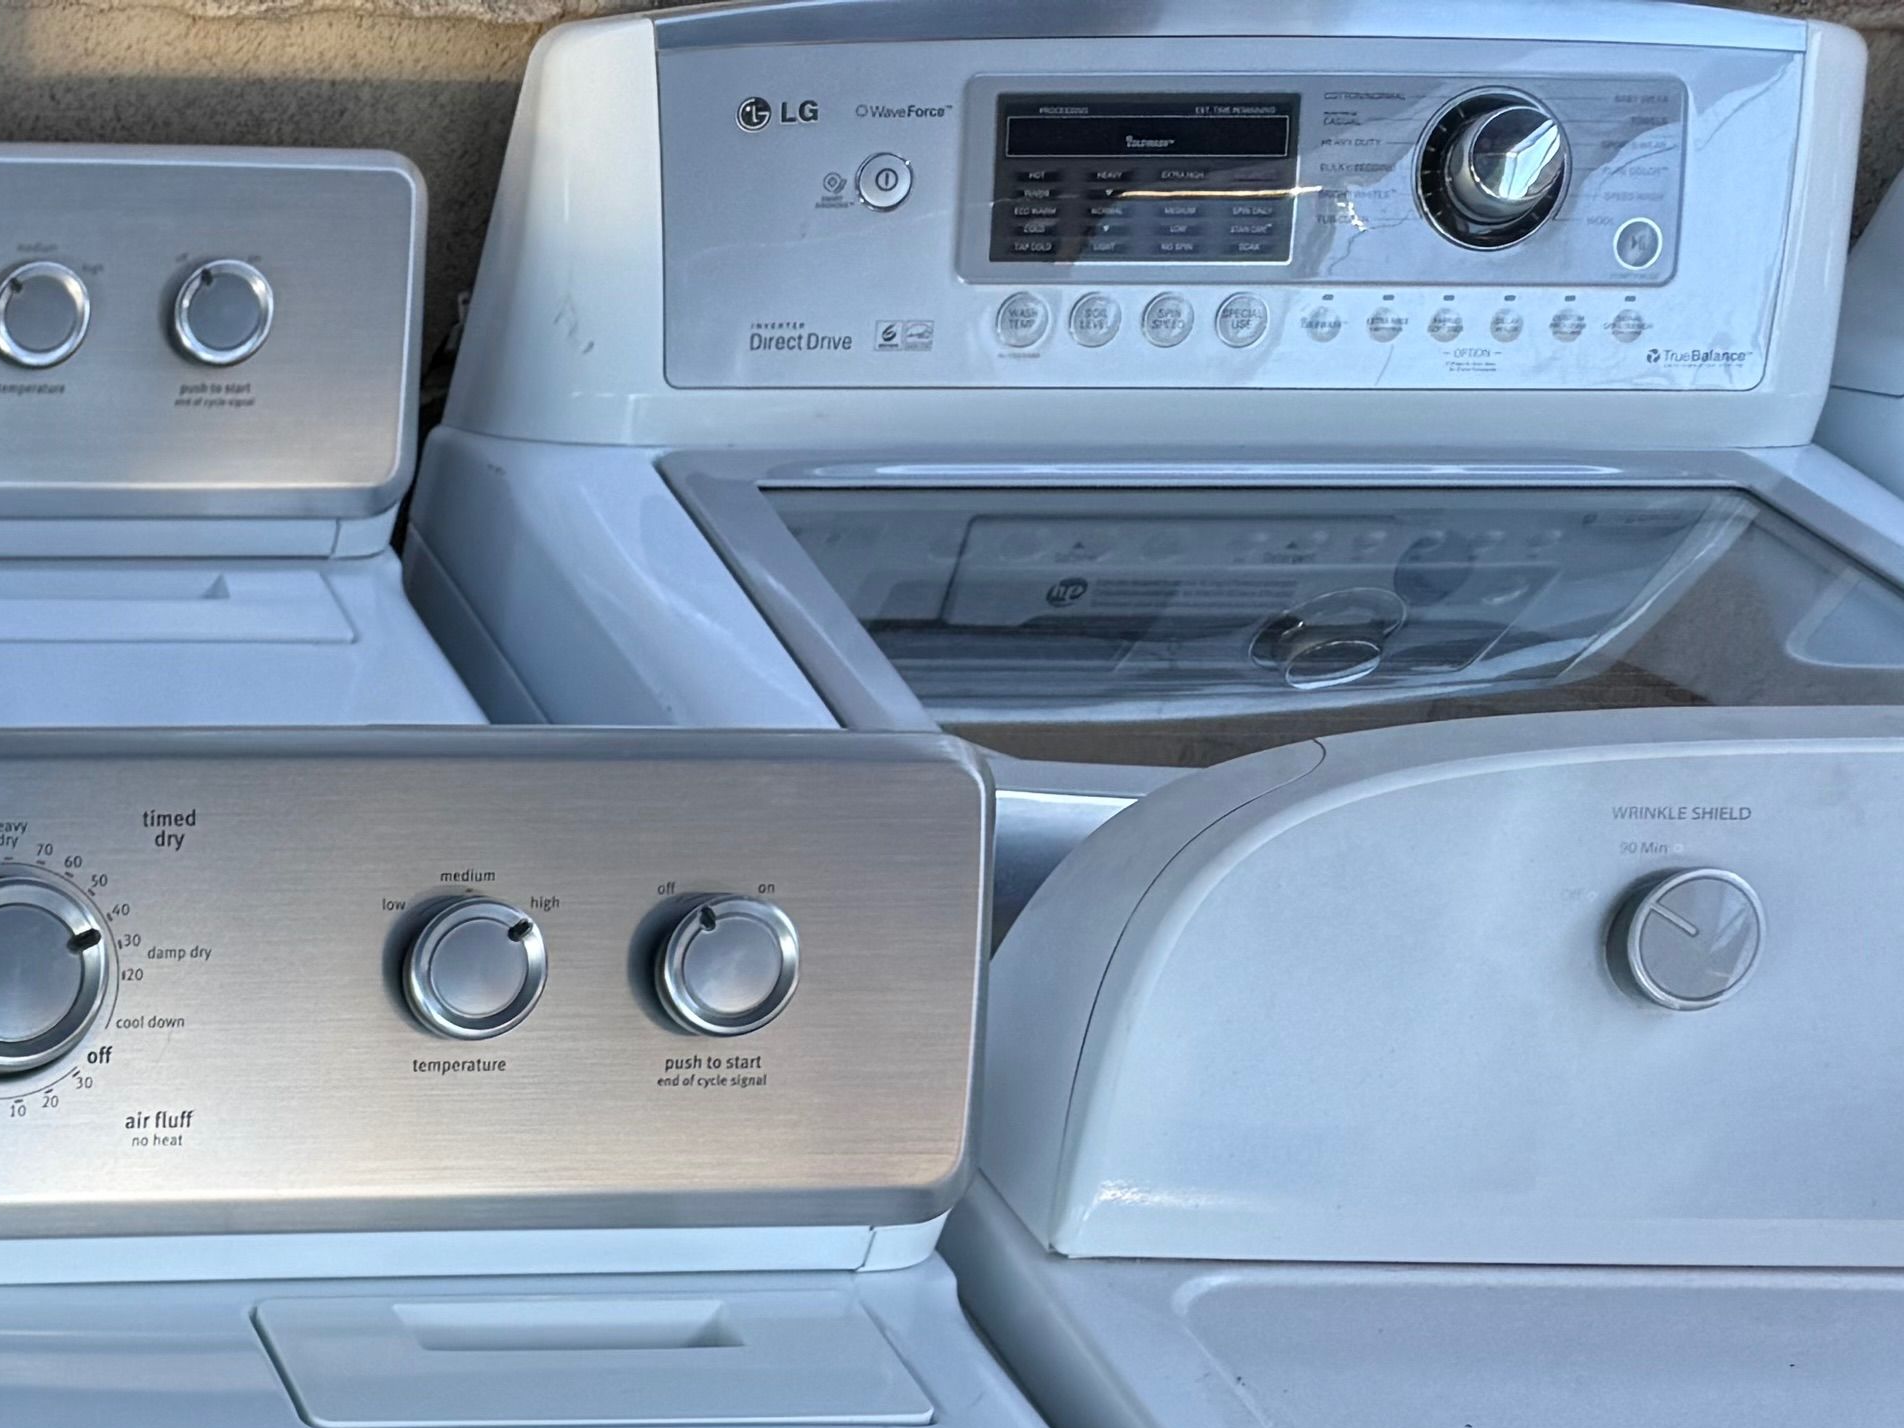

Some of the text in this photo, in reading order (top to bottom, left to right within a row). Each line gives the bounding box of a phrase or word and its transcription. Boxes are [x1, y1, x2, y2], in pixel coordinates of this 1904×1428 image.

[781, 100, 818, 123] LG
[1222, 308, 1262, 318] SPECIAL
[750, 333, 852, 351] Direct Drive
[142, 809, 196, 828] timed
[1613, 806, 1752, 820] WRINKLE SHIELD
[154, 830, 186, 851] dry
[1640, 841, 1668, 854] Min
[37, 843, 54, 857] 70
[64, 855, 82, 869] 60
[91, 874, 108, 888] 50
[440, 869, 496, 882] medium
[657, 881, 676, 895] off
[758, 882, 775, 894] on
[112, 903, 130, 917] 40
[382, 898, 405, 911] low
[530, 896, 560, 911] high
[124, 934, 141, 948] 30
[147, 946, 212, 963] damp dry
[127, 968, 144, 982] 20
[116, 1016, 185, 1029] cool down
[86, 1046, 113, 1065] off
[412, 1058, 506, 1075] temperature
[665, 1055, 762, 1072] push to start
[76, 1076, 93, 1089] 30
[657, 1073, 767, 1088] end of cycle signal
[41, 1095, 59, 1109] 20
[10, 1105, 26, 1117] 10
[124, 1110, 194, 1130] air fluff
[131, 1134, 183, 1147] no heat
